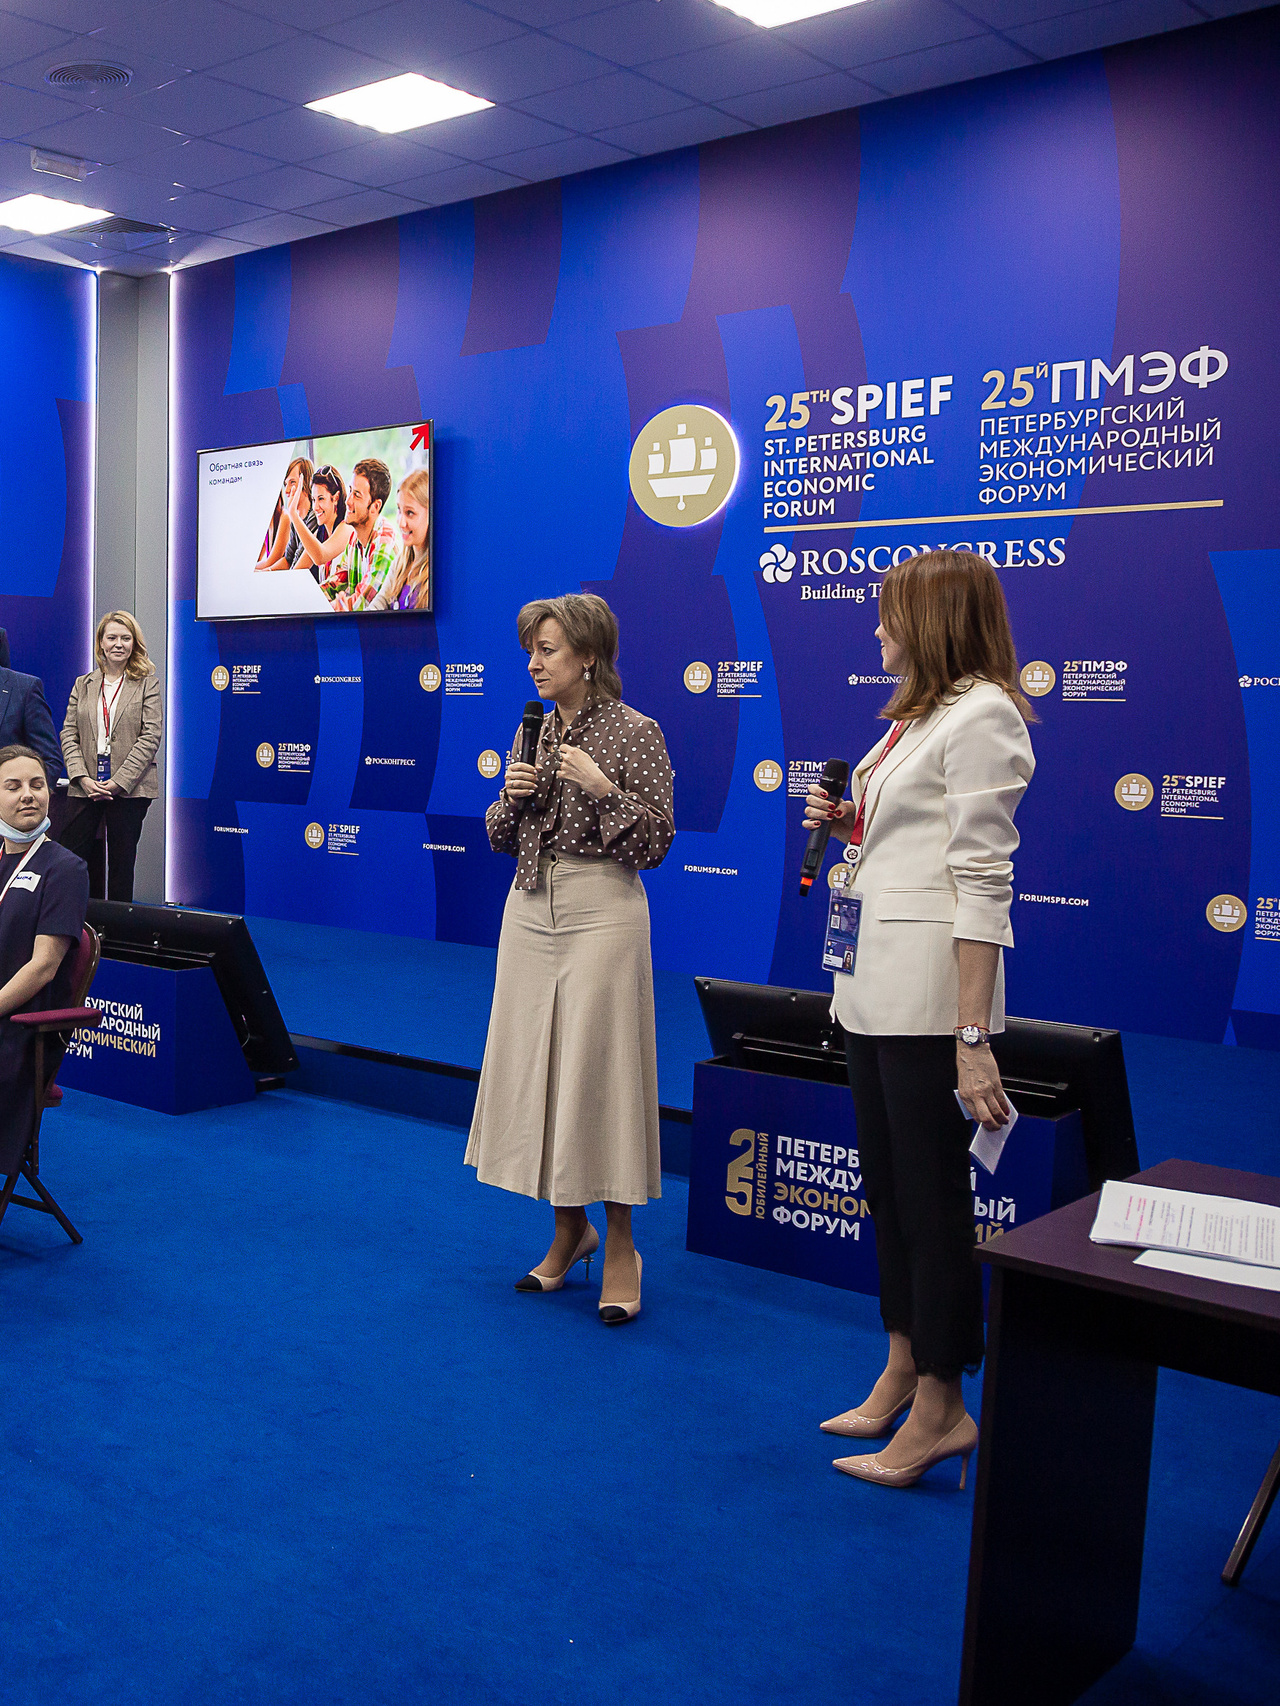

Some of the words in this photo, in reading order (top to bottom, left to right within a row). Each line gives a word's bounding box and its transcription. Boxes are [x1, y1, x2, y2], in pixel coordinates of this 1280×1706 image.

[1050, 344, 1230, 404] ПМЭФ
[831, 374, 954, 425] SPIEF
[980, 397, 1187, 438] ПЕТЕРБУРГСКИЙ
[763, 440, 792, 457] ST.
[796, 425, 927, 454] PETERSBURG
[979, 419, 1223, 461] МЕЖДУНАРОДНЫЙ
[209, 461, 243, 473] Обратная
[244, 459, 264, 468] связь
[763, 447, 935, 478] INTERNATIONAL
[978, 444, 1216, 484] ЭКОНОМИЧЕСКИЙ
[208, 476, 243, 486] командам
[763, 473, 876, 499] ECONOMIC
[978, 481, 1067, 507] ФОРУМ
[763, 498, 836, 520] FORUM
[801, 537, 1066, 577] ROSCORESS
[801, 584, 866, 603] Building
[1082, 660, 1128, 672] ПМЭФ
[1172, 788, 1217, 796] PETERSBURG
[1185, 776, 1226, 789] SPIEF
[1161, 794, 1219, 803] INTERNATIONAL
[1161, 800, 1200, 808] ECONOMIC
[1161, 806, 1187, 814] FORUM
[422, 843, 466, 853] FORUMSPB.COM
[684, 864, 738, 876] FORUMSPB.COM
[1019, 893, 1090, 907] FORUMSPB.COM
[98, 1016, 161, 1042] АРОДНЫЙ
[65, 1041, 93, 1060] РУМ
[777, 1135, 860, 1169] ПЕТЕРБ
[756, 1132, 769, 1220] ЮБИЛЕЙНЫЙ
[775, 1157, 862, 1193] МЕЖДУ
[772, 1206, 860, 1241] ФОРУМ
